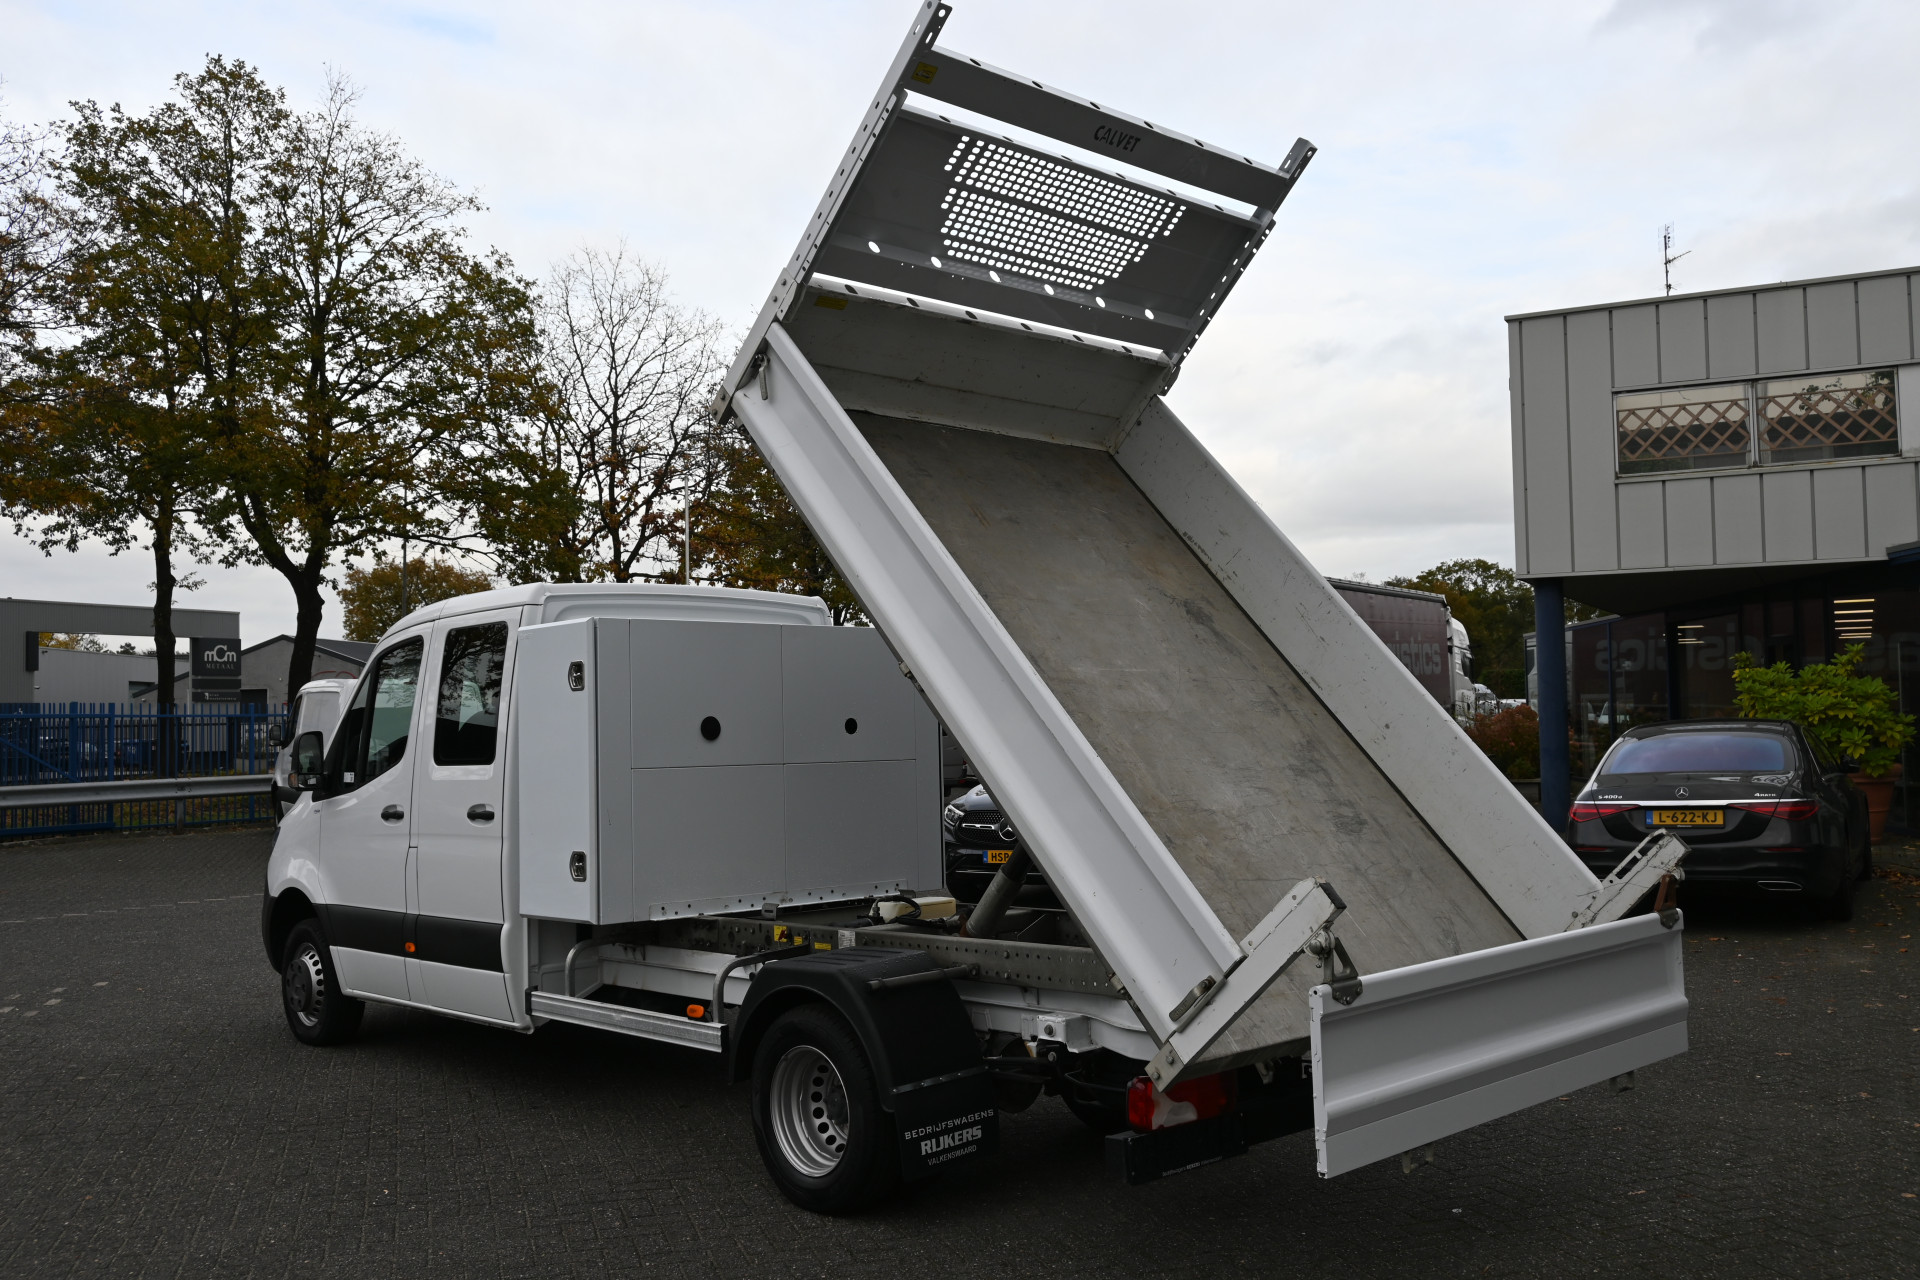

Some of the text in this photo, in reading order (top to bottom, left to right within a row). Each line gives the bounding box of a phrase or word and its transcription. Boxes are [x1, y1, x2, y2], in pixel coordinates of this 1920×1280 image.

[1094, 125, 1141, 152] CALVET
[1658, 811, 1718, 823] L-622-KJ
[904, 1108, 994, 1140] BEDRIJFSWAGENS
[920, 1125, 982, 1156] RIJKERS
[927, 1144, 977, 1166] VALKENSWAARD
